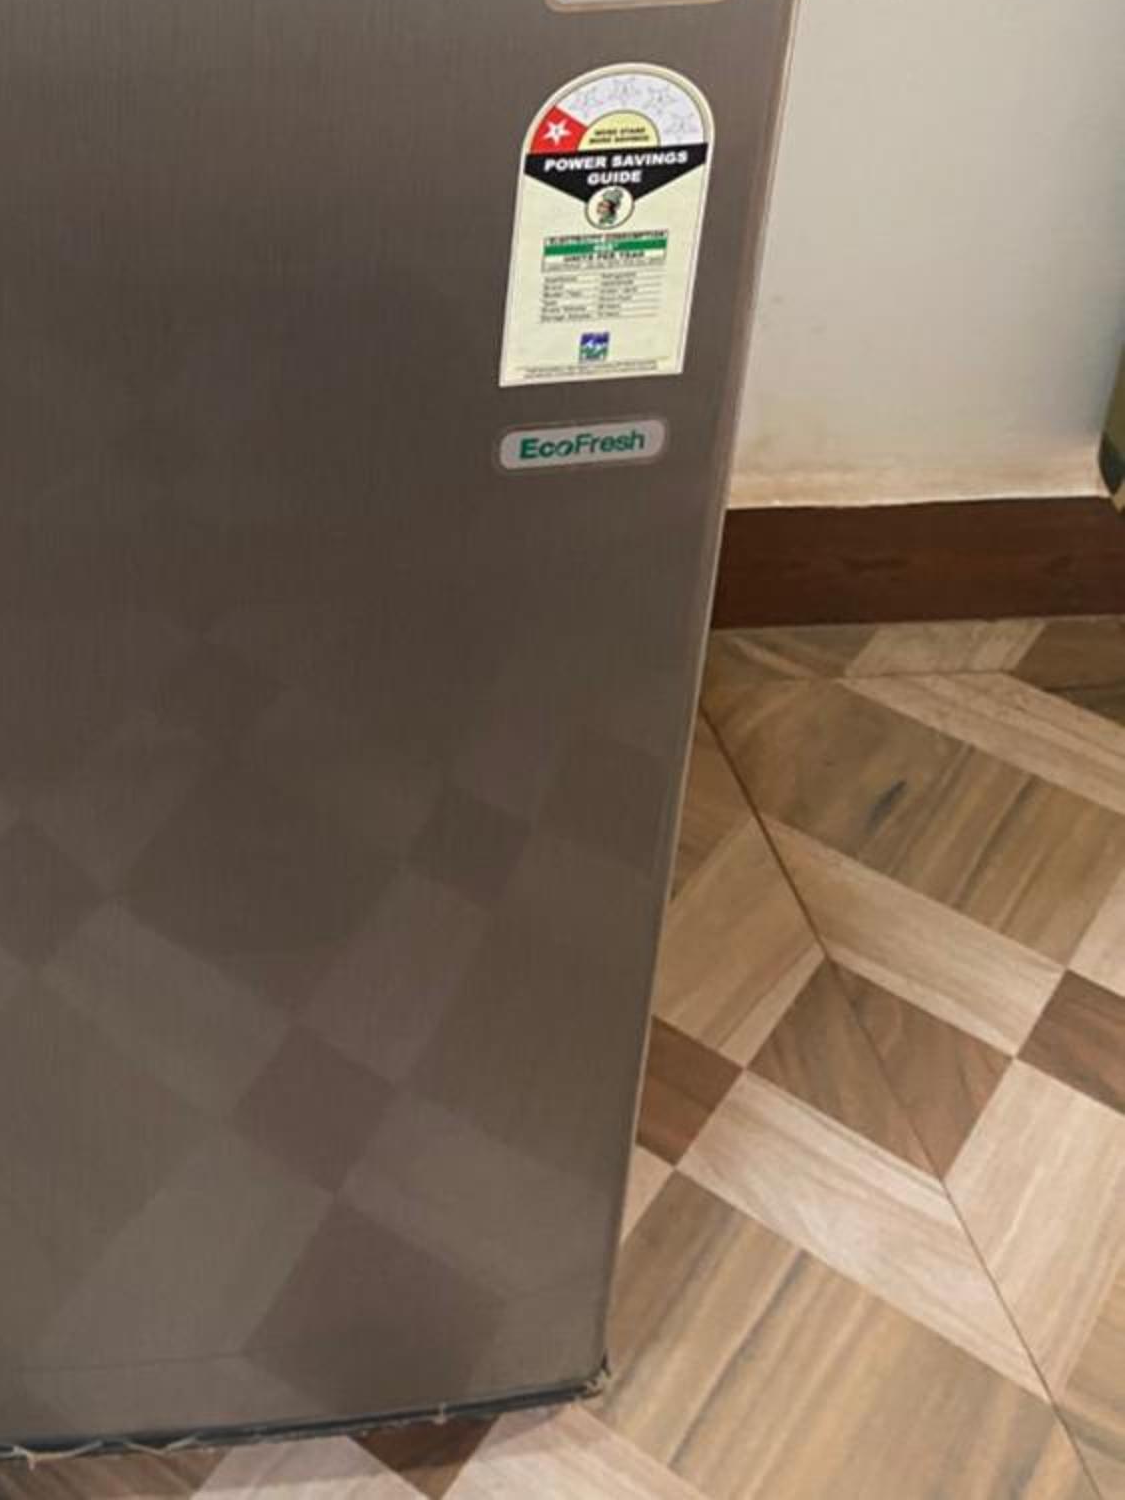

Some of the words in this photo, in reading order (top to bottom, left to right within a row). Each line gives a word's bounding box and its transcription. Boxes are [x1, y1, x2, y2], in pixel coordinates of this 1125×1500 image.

[543, 154, 607, 172] POWER
[611, 150, 689, 168] SAVINGS
[586, 169, 642, 186] GUIDE
[518, 430, 646, 460] EcoFresh
